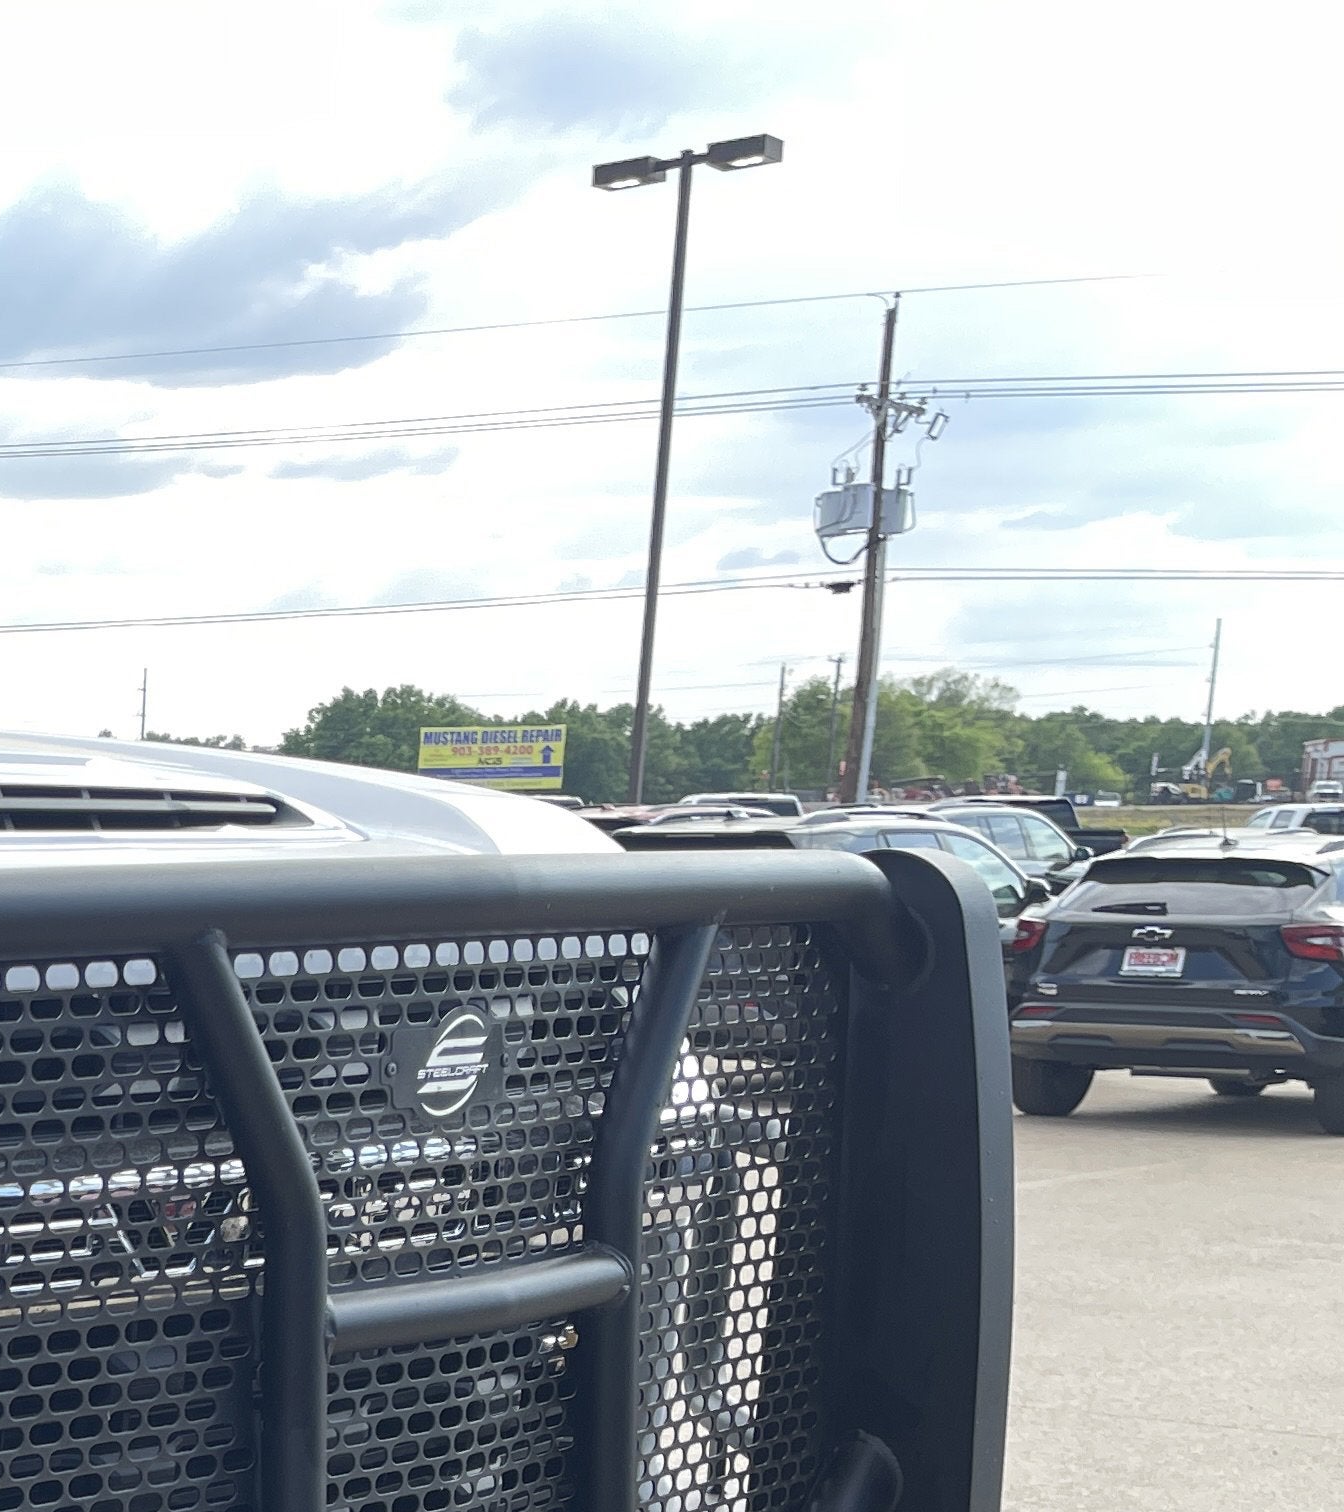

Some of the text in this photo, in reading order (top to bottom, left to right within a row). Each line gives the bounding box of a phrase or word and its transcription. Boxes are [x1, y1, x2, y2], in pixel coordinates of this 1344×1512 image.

[423, 728, 562, 745] MUSTANG DIESEL REPAIR
[451, 745, 534, 757] 903-389-4200
[416, 1063, 489, 1080] STEELCRAFT
